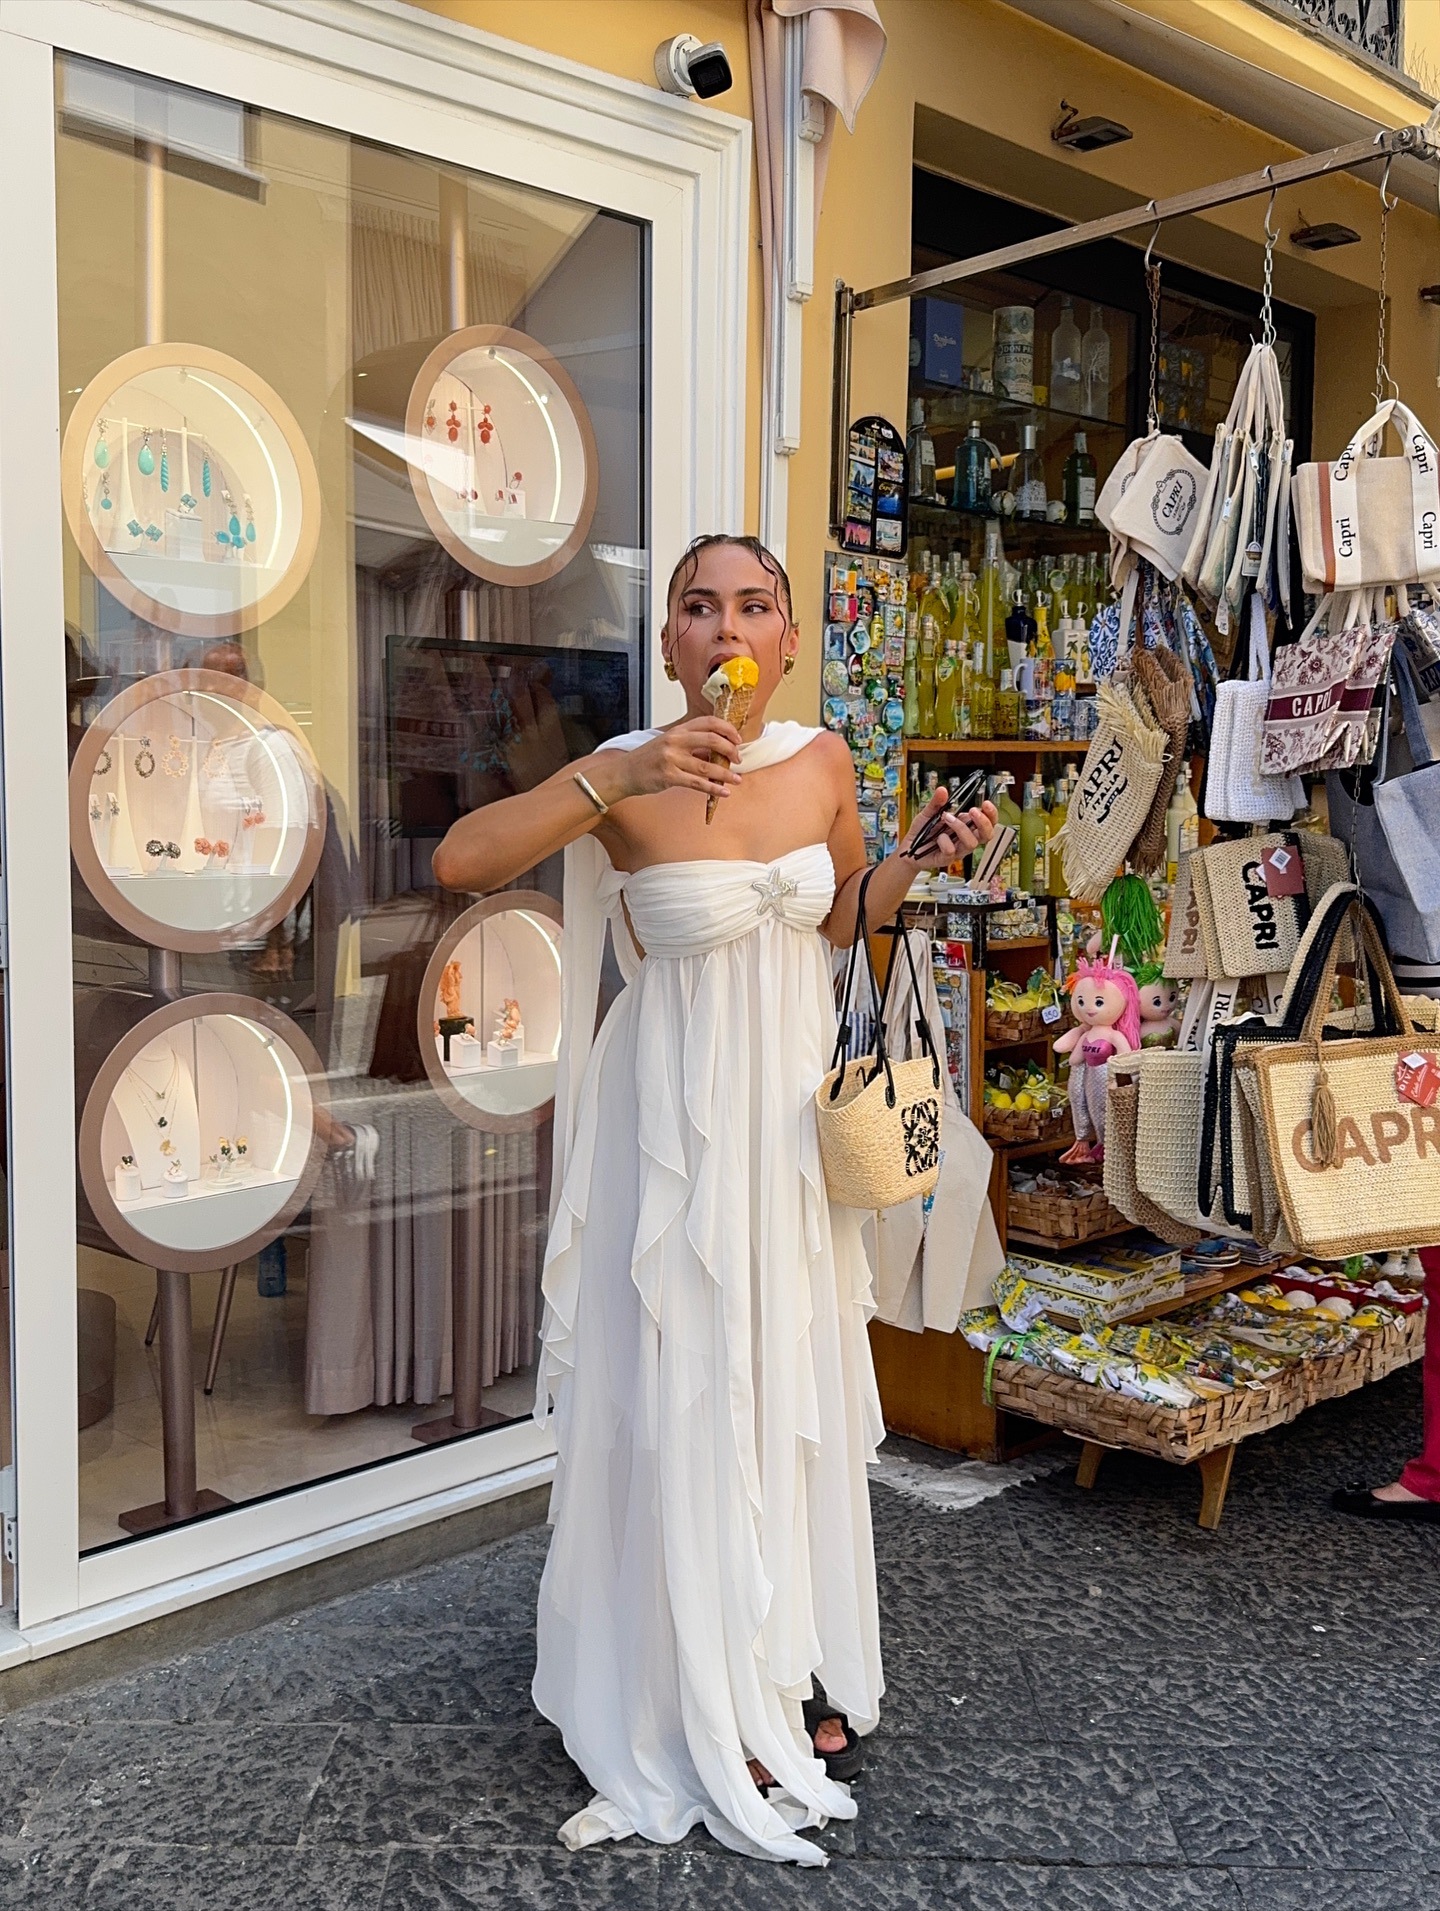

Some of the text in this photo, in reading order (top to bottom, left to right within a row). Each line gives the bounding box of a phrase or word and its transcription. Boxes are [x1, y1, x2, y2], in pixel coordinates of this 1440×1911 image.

[1412, 434, 1433, 474] Capri
[1162, 479, 1183, 518] CAPRI
[1335, 517, 1356, 557] Capri
[1418, 511, 1437, 550] Capri
[1291, 689, 1333, 717] CAPRI
[1078, 735, 1123, 820] CAPRI
[1092, 773, 1120, 811] ITALIA
[1242, 861, 1280, 949] CAPRI
[1072, 1282, 1104, 1296] PAESTUM
